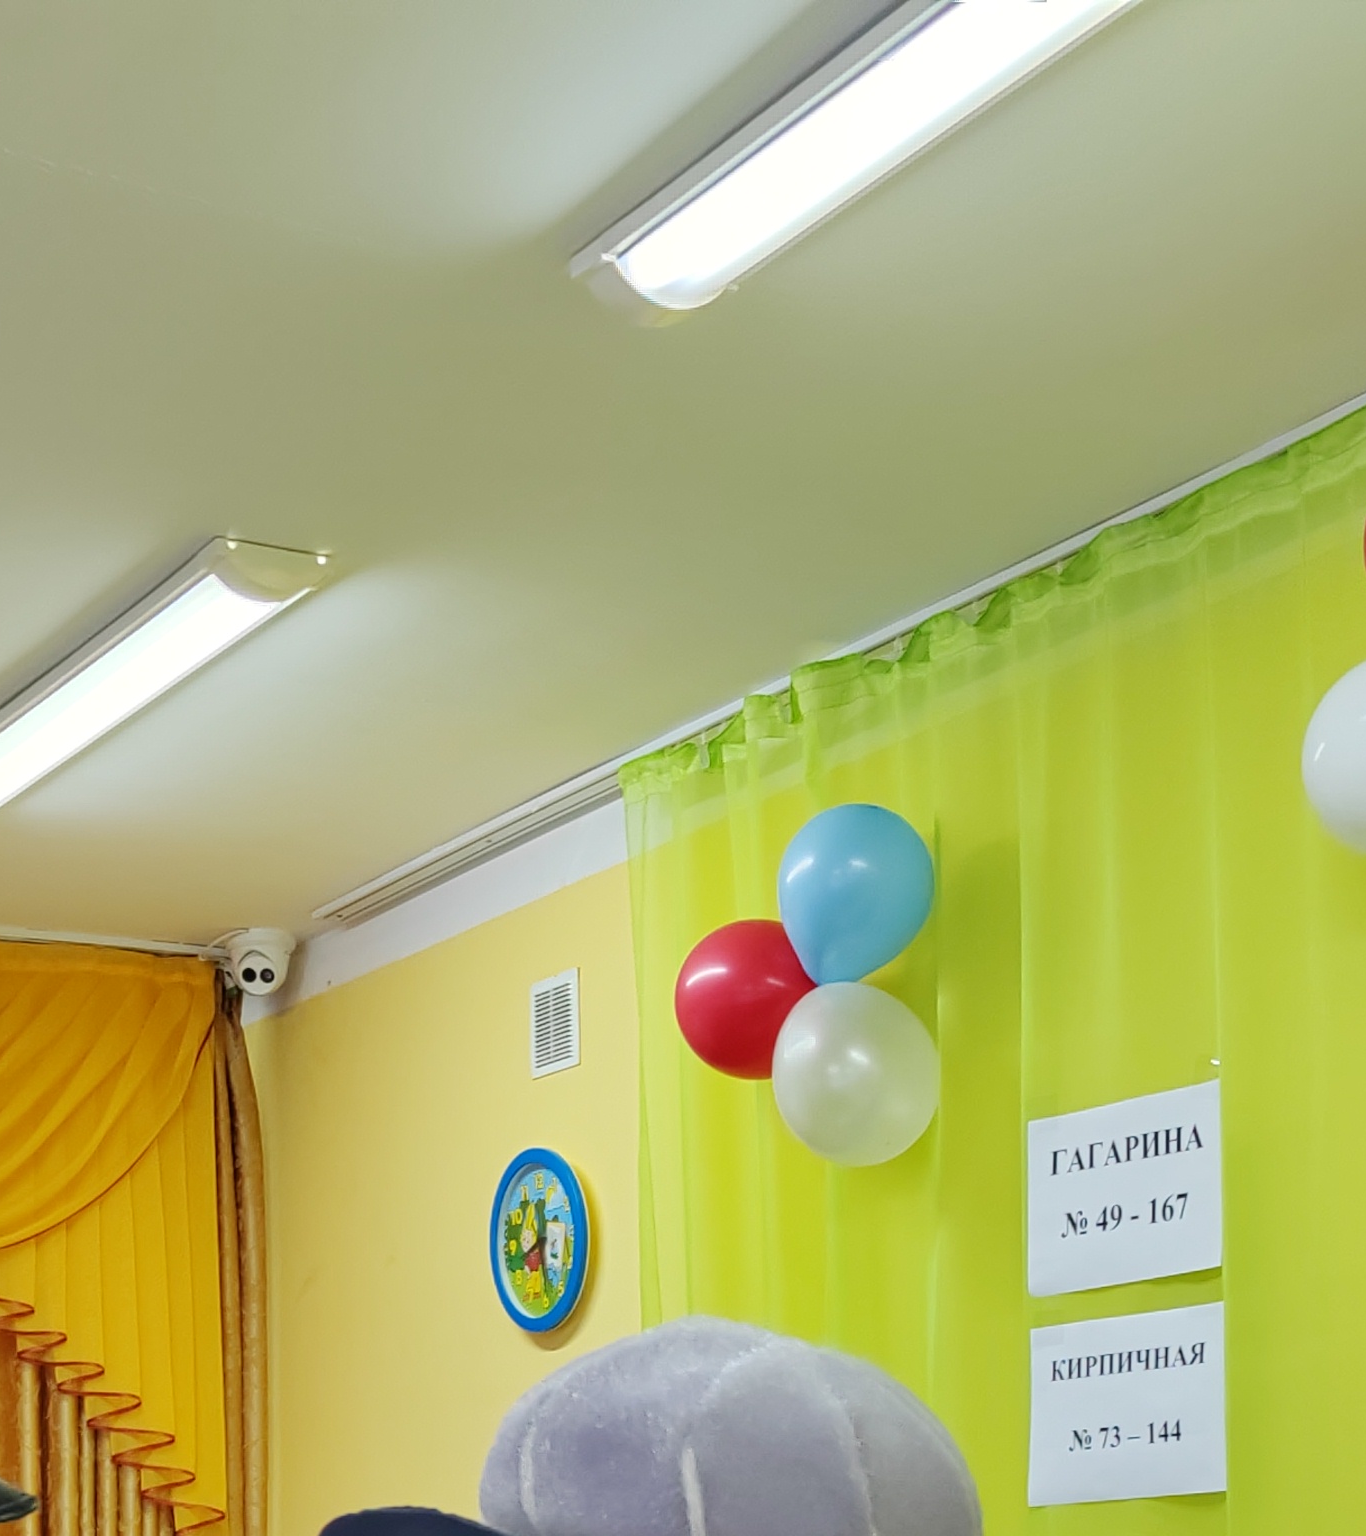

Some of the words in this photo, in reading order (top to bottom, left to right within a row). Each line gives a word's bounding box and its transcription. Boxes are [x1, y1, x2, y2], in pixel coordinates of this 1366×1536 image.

[1050, 1124, 1204, 1176] ГАГАРИНА
[508, 1208, 523, 1226] 10
[1061, 1210, 1088, 1239] №
[1095, 1204, 1123, 1232] 49
[1148, 1192, 1189, 1225] 167
[509, 1240, 517, 1256] 9
[1050, 1342, 1206, 1382] КИРПИЧНАЯ
[1068, 1429, 1092, 1452] №
[1098, 1425, 1122, 1449] 73
[1146, 1419, 1183, 1444] 144
